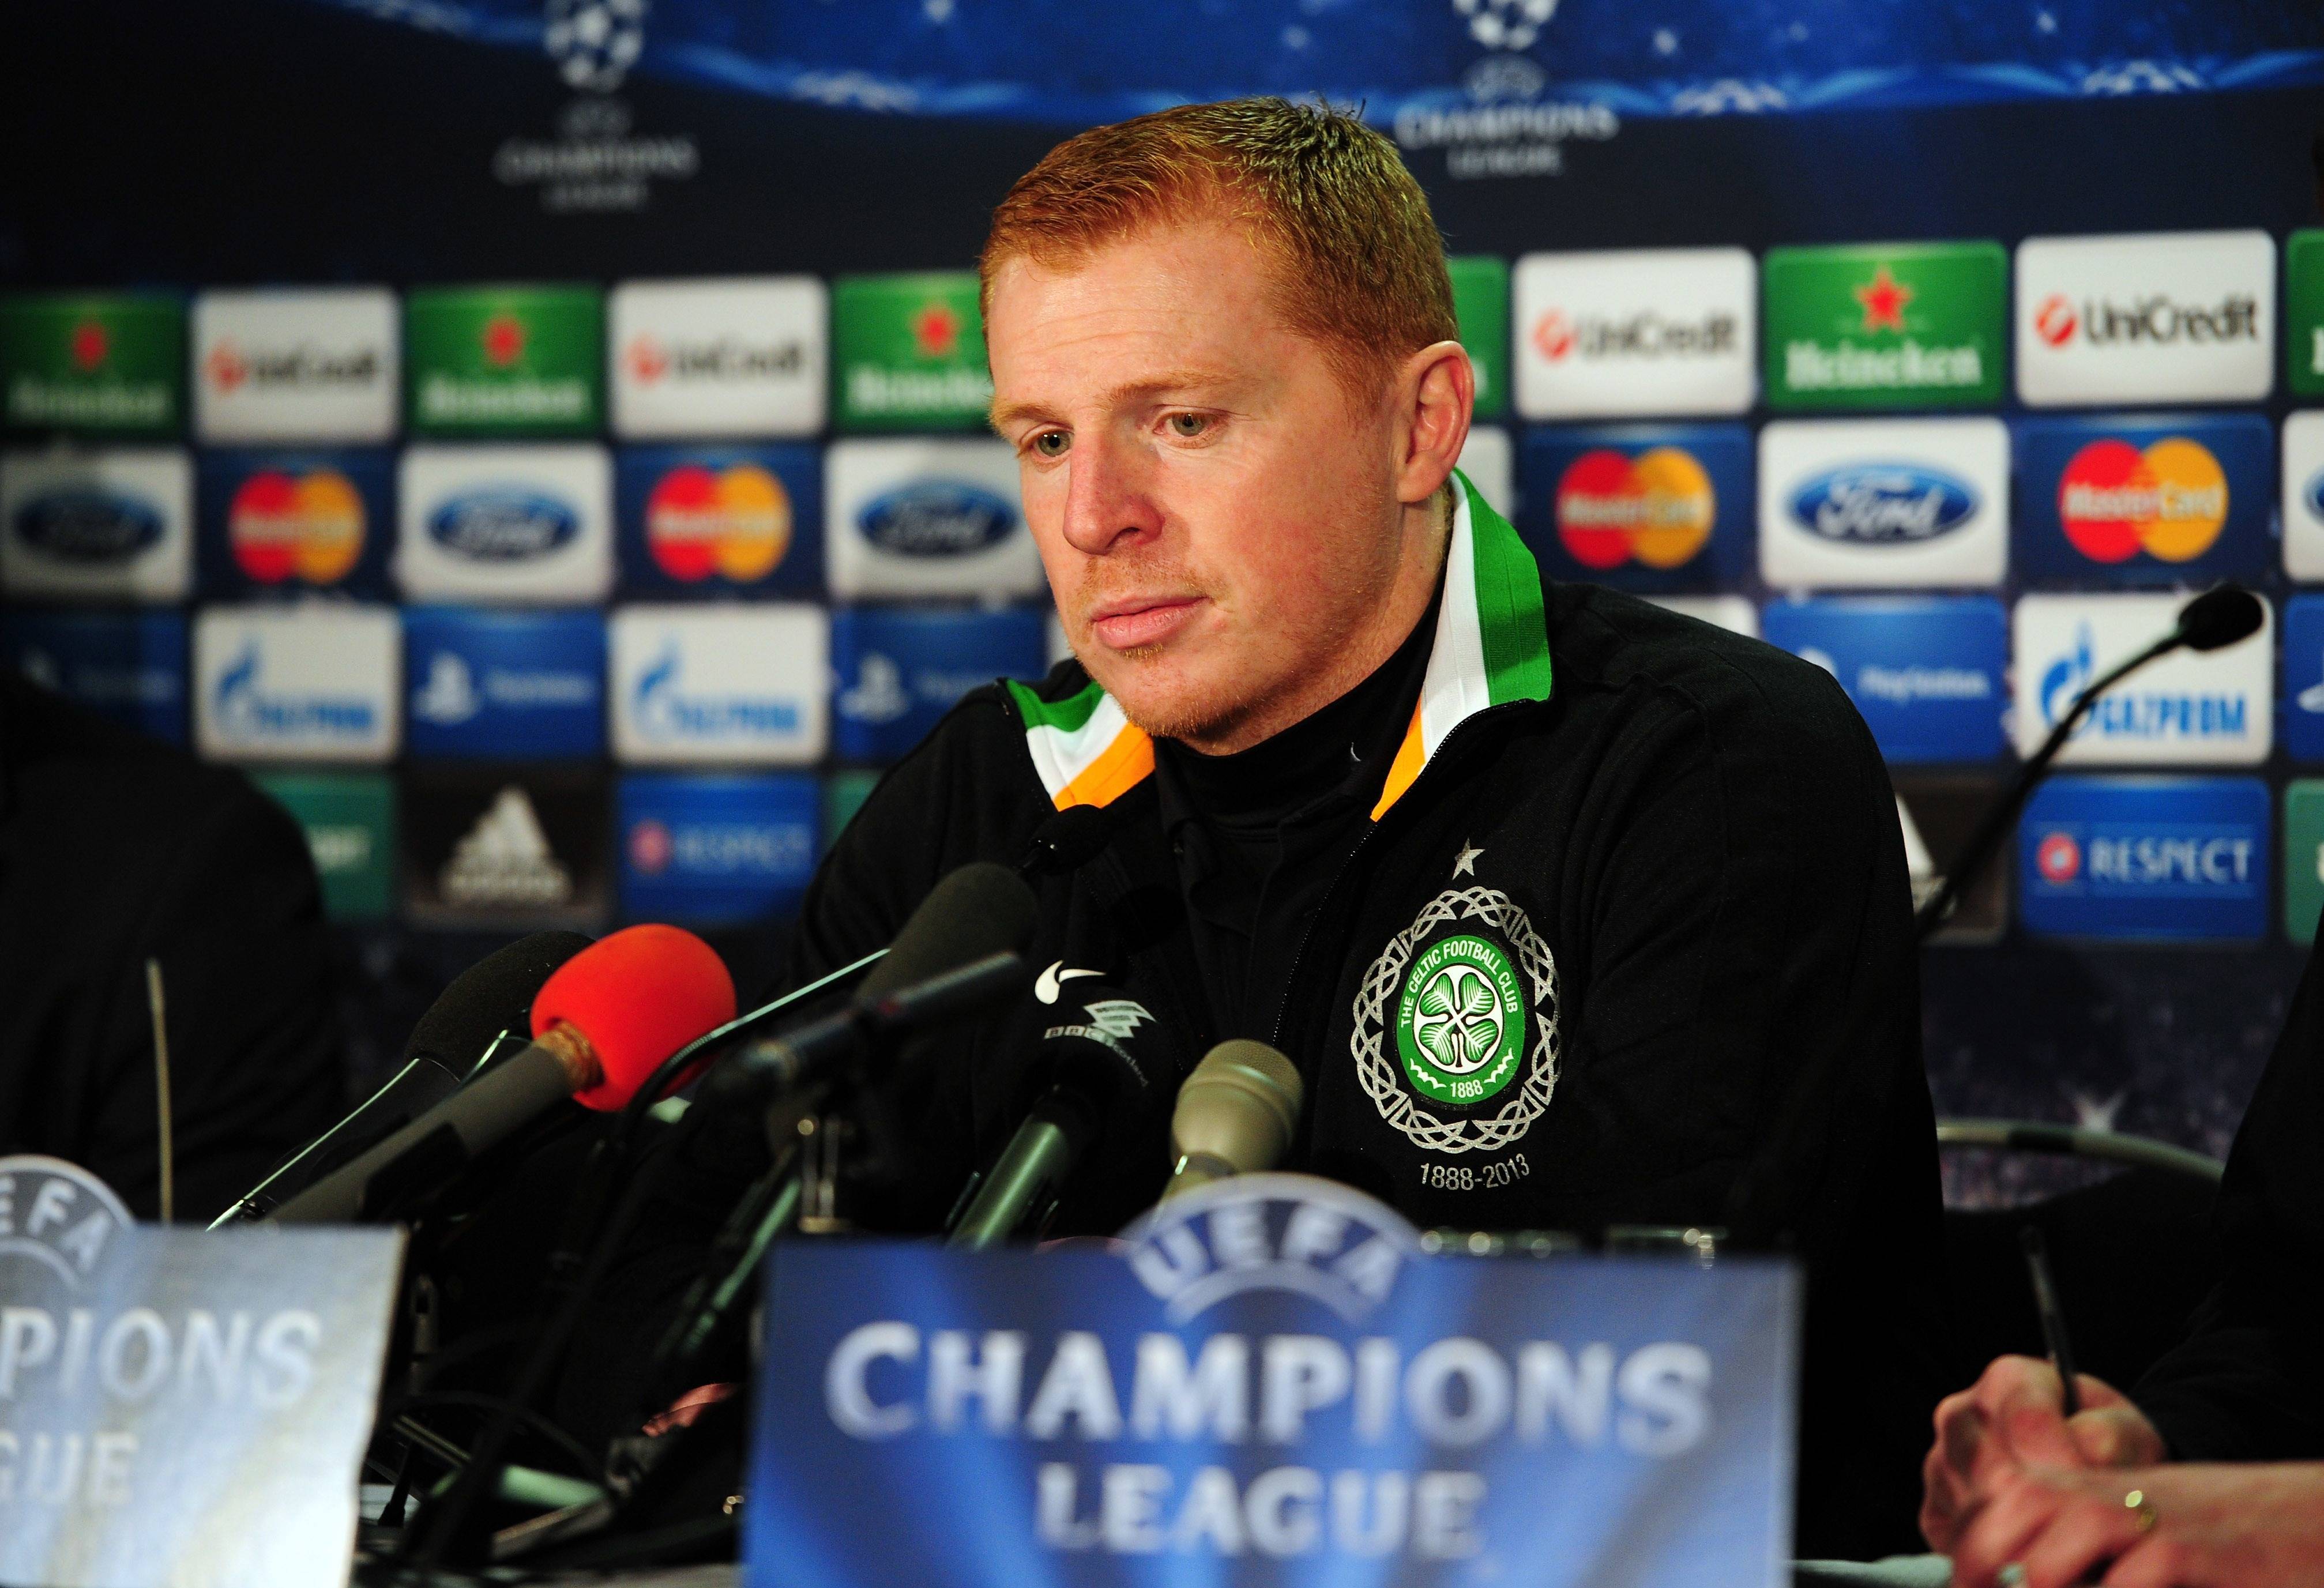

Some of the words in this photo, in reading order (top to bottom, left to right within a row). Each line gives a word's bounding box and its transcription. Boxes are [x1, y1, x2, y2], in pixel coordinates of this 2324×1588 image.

[2083, 295, 2258, 344] UniCredit
[1787, 340, 1983, 390] Heineken
[1817, 474, 1946, 539] Ford
[2064, 481, 2224, 520] MasterCard
[2099, 694, 2246, 734] GAZPROM
[2089, 837, 2251, 883] RESPECT
[1400, 996, 1415, 1028] THE
[1408, 949, 1442, 994] CELTIC
[1443, 939, 1502, 976] FOOTBALL
[1497, 971, 1519, 1014] CLUB
[1450, 1079, 1484, 1098] 1888
[1419, 1153, 1530, 1191] 1888-2013
[1131, 1204, 1405, 1300] UEFA
[823, 1320, 1714, 1457] CHAMPIONS
[1036, 1461, 1489, 1559] LEAGUE
